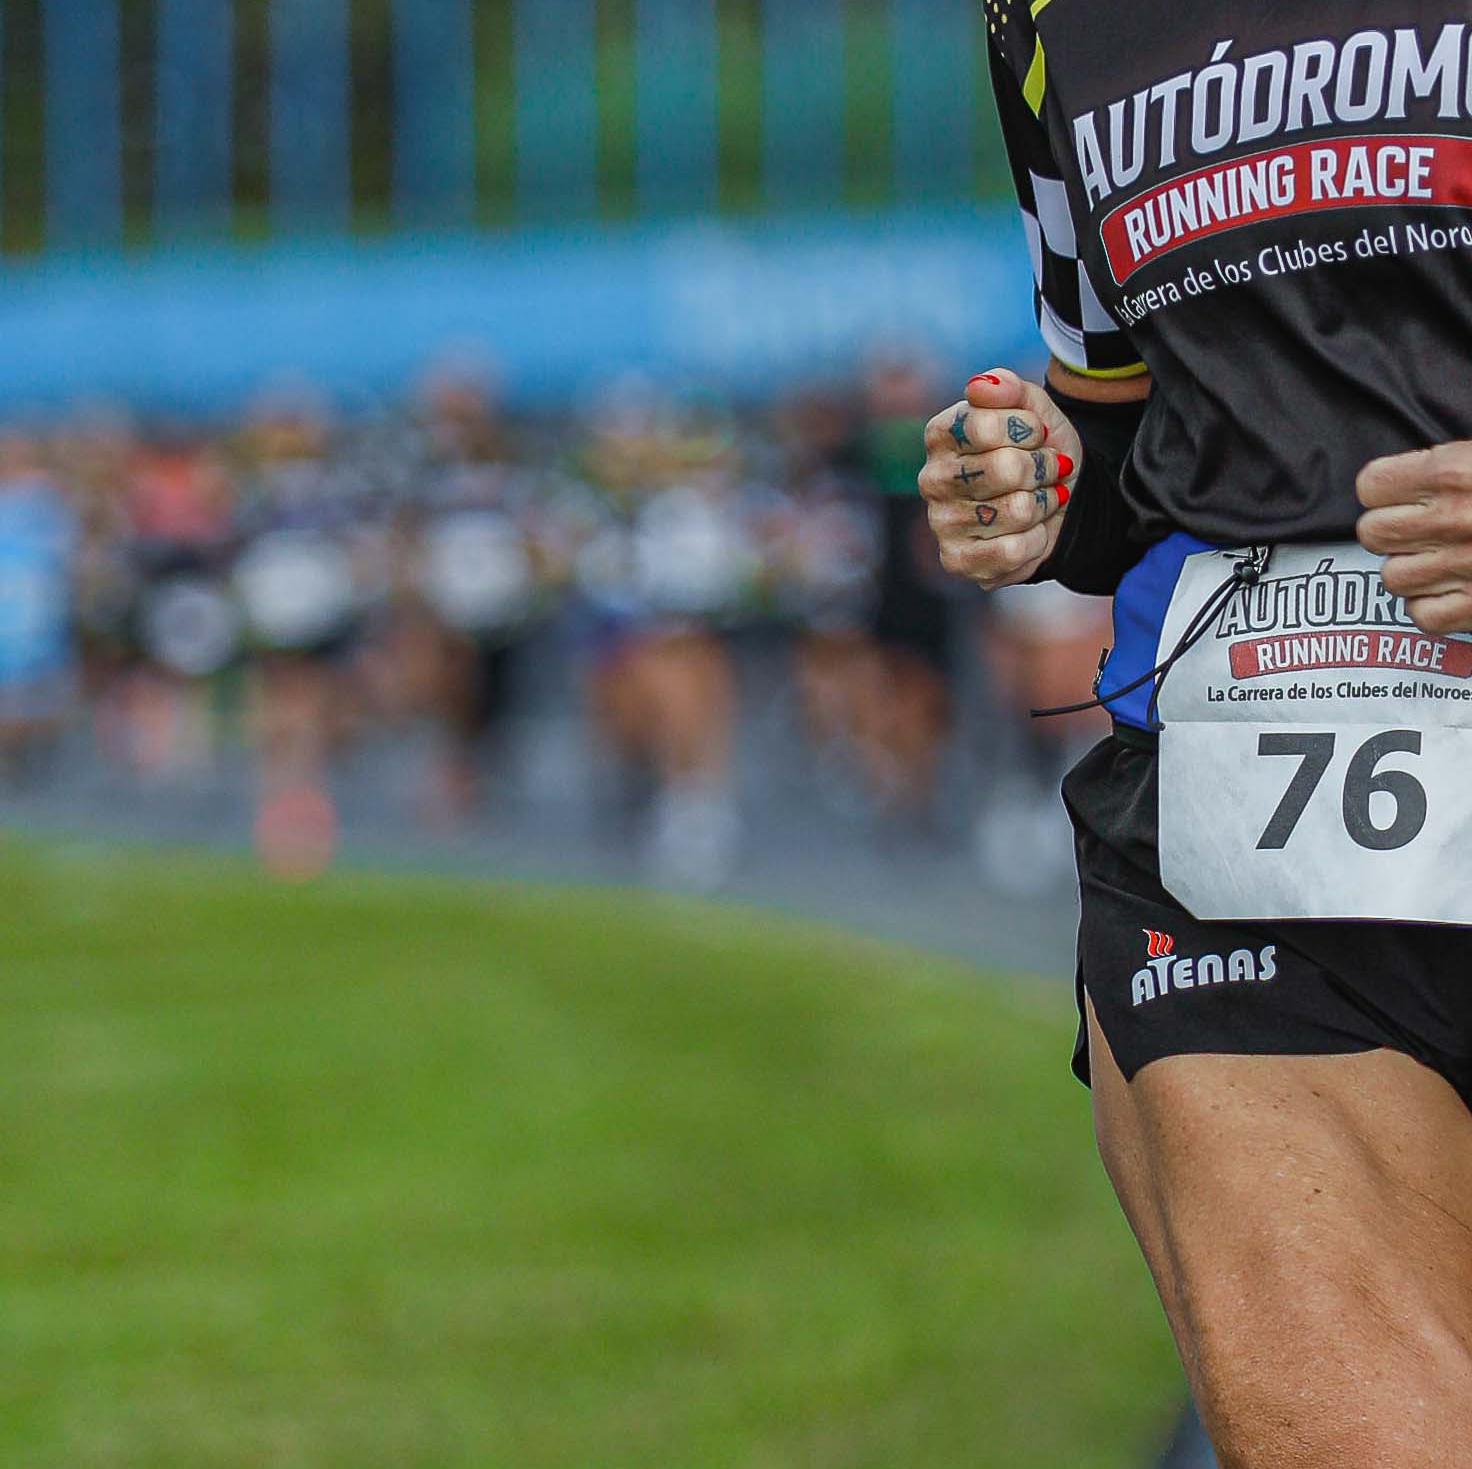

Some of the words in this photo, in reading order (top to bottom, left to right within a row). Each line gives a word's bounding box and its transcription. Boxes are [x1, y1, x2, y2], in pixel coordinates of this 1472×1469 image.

[1122, 154, 1297, 263] RUNNING
[1310, 145, 1435, 201] RACE
[1123, 281, 1183, 321] Carrera
[1183, 266, 1216, 296] de
[1213, 258, 1252, 286] los
[1257, 239, 1348, 276] Clubes
[1354, 225, 1399, 258] del
[1207, 686, 1225, 702] La
[1227, 685, 1284, 702] Carrera
[1287, 682, 1307, 700] de
[1310, 682, 1333, 699] los
[1336, 681, 1389, 699] Clubes
[1391, 681, 1417, 699] del
[1256, 634, 1369, 672] RUNNING
[1376, 634, 1447, 671] RACE
[1255, 729, 1428, 850] 76
[1131, 945, 1276, 1007] ATENAS
